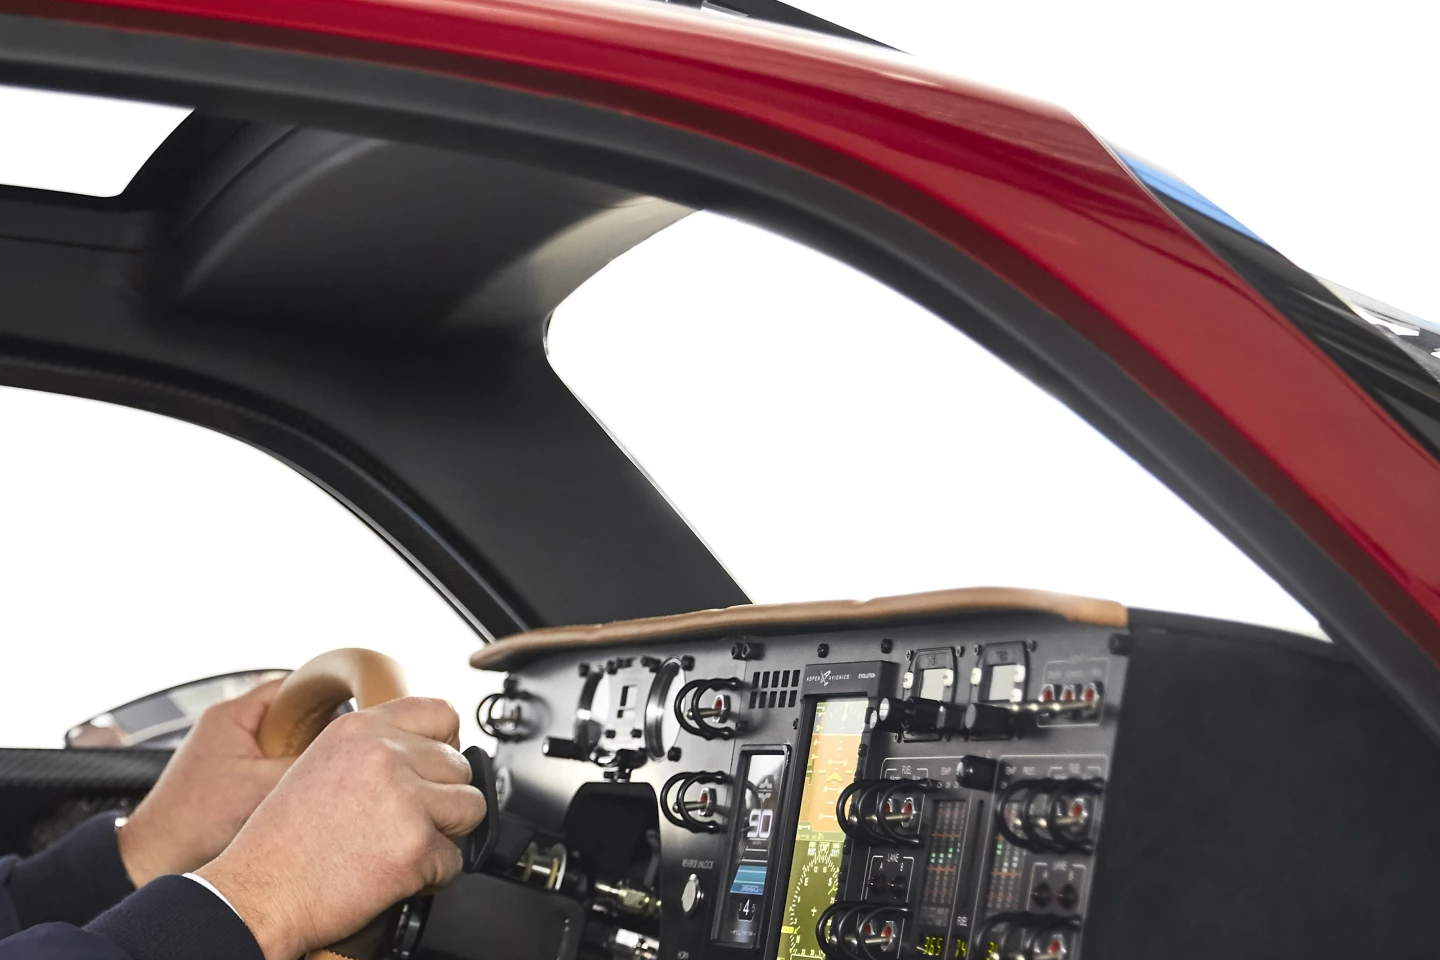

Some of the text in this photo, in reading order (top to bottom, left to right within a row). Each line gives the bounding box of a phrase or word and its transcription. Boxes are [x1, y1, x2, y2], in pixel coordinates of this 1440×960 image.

[828, 673, 850, 681] AVIONICS
[747, 808, 773, 838] 90
[804, 877, 833, 887] E S
[742, 899, 750, 916] 4
